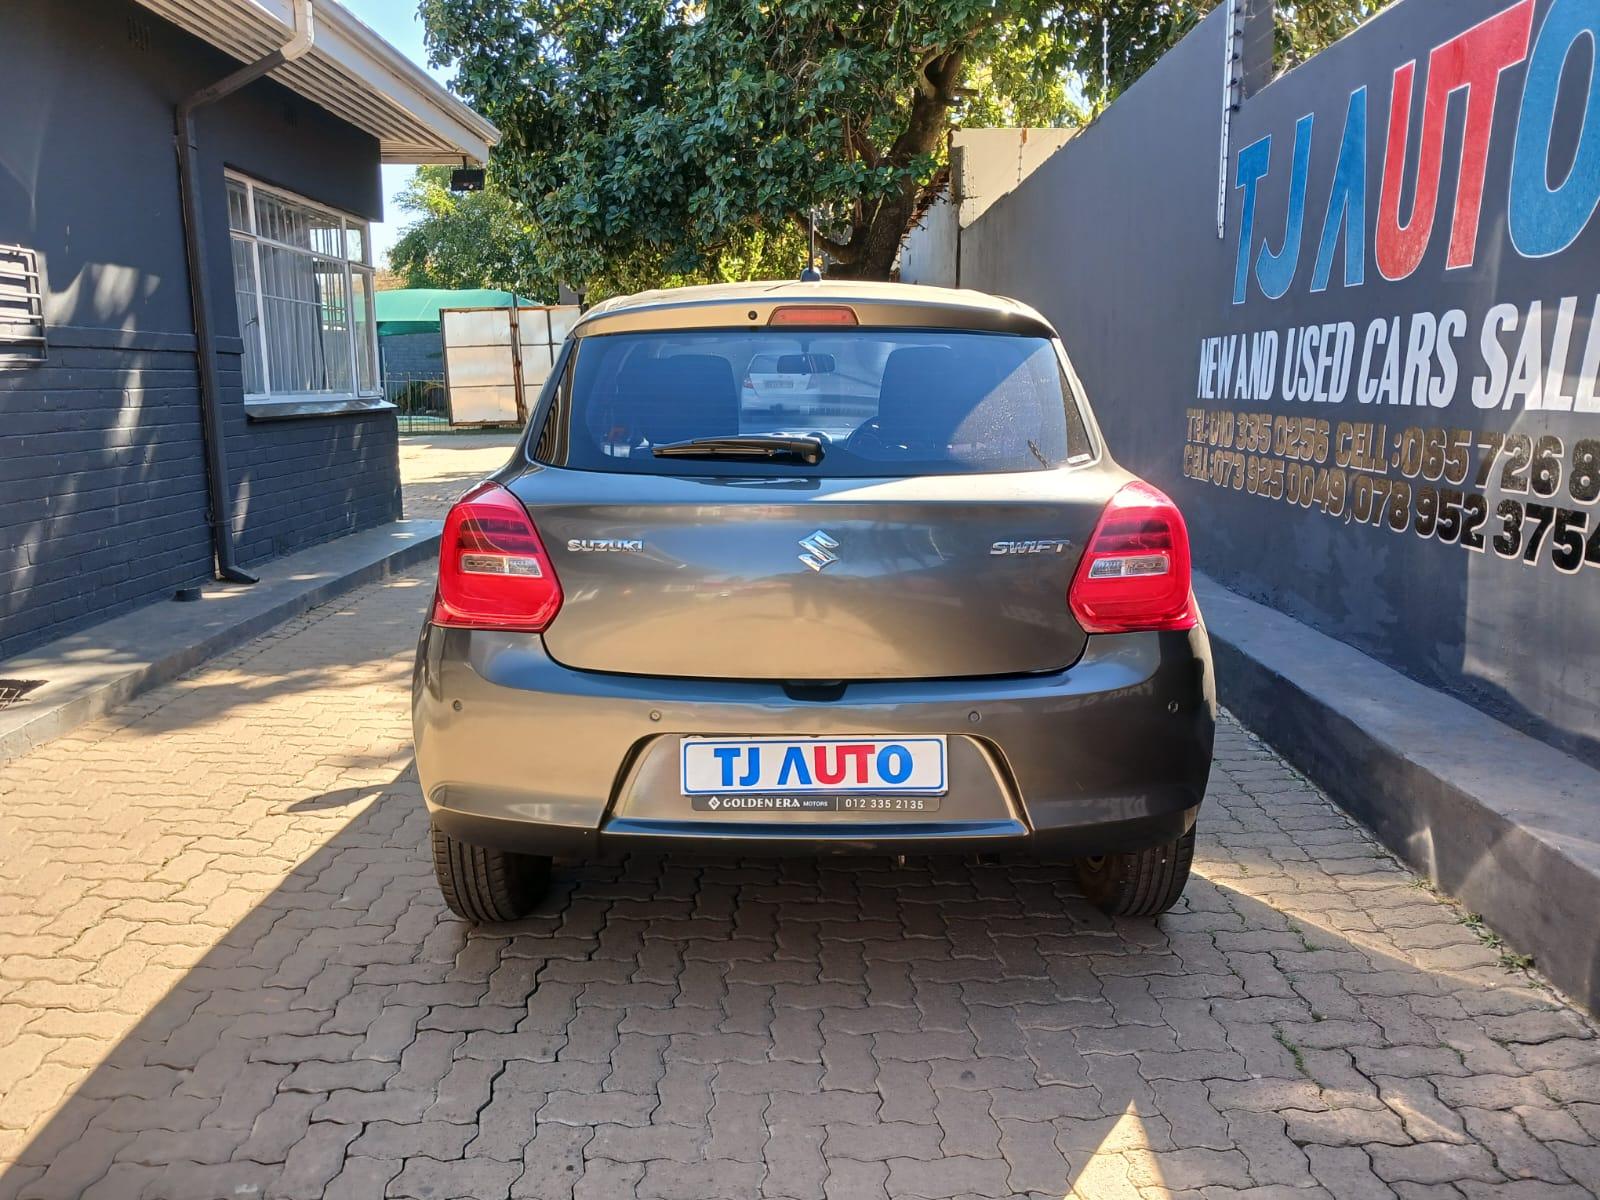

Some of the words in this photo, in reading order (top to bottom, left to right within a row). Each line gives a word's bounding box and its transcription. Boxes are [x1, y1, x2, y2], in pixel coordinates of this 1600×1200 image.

[1233, 134, 1314, 304] TJ
[1310, 0, 1600, 293] AUTO
[1197, 334, 1237, 399] NEW
[1234, 331, 1279, 400] AND
[1282, 321, 1355, 403] USED
[1357, 308, 1467, 408] CARS
[1236, 412, 1273, 454] 335
[1274, 415, 1330, 464] 0256
[1475, 432, 1565, 499] 726
[1247, 455, 1285, 500] 925
[1415, 486, 1490, 553] 952
[567, 539, 643, 552] SUZUKI
[989, 539, 1072, 555] SWIFT
[713, 747, 760, 787] TJ
[777, 744, 913, 785] AUTO
[723, 798, 773, 808] GOLDEN
[775, 798, 800, 808] ERA
[845, 798, 866, 808] 012
[870, 799, 891, 809] 335
[896, 799, 924, 810] 2135
